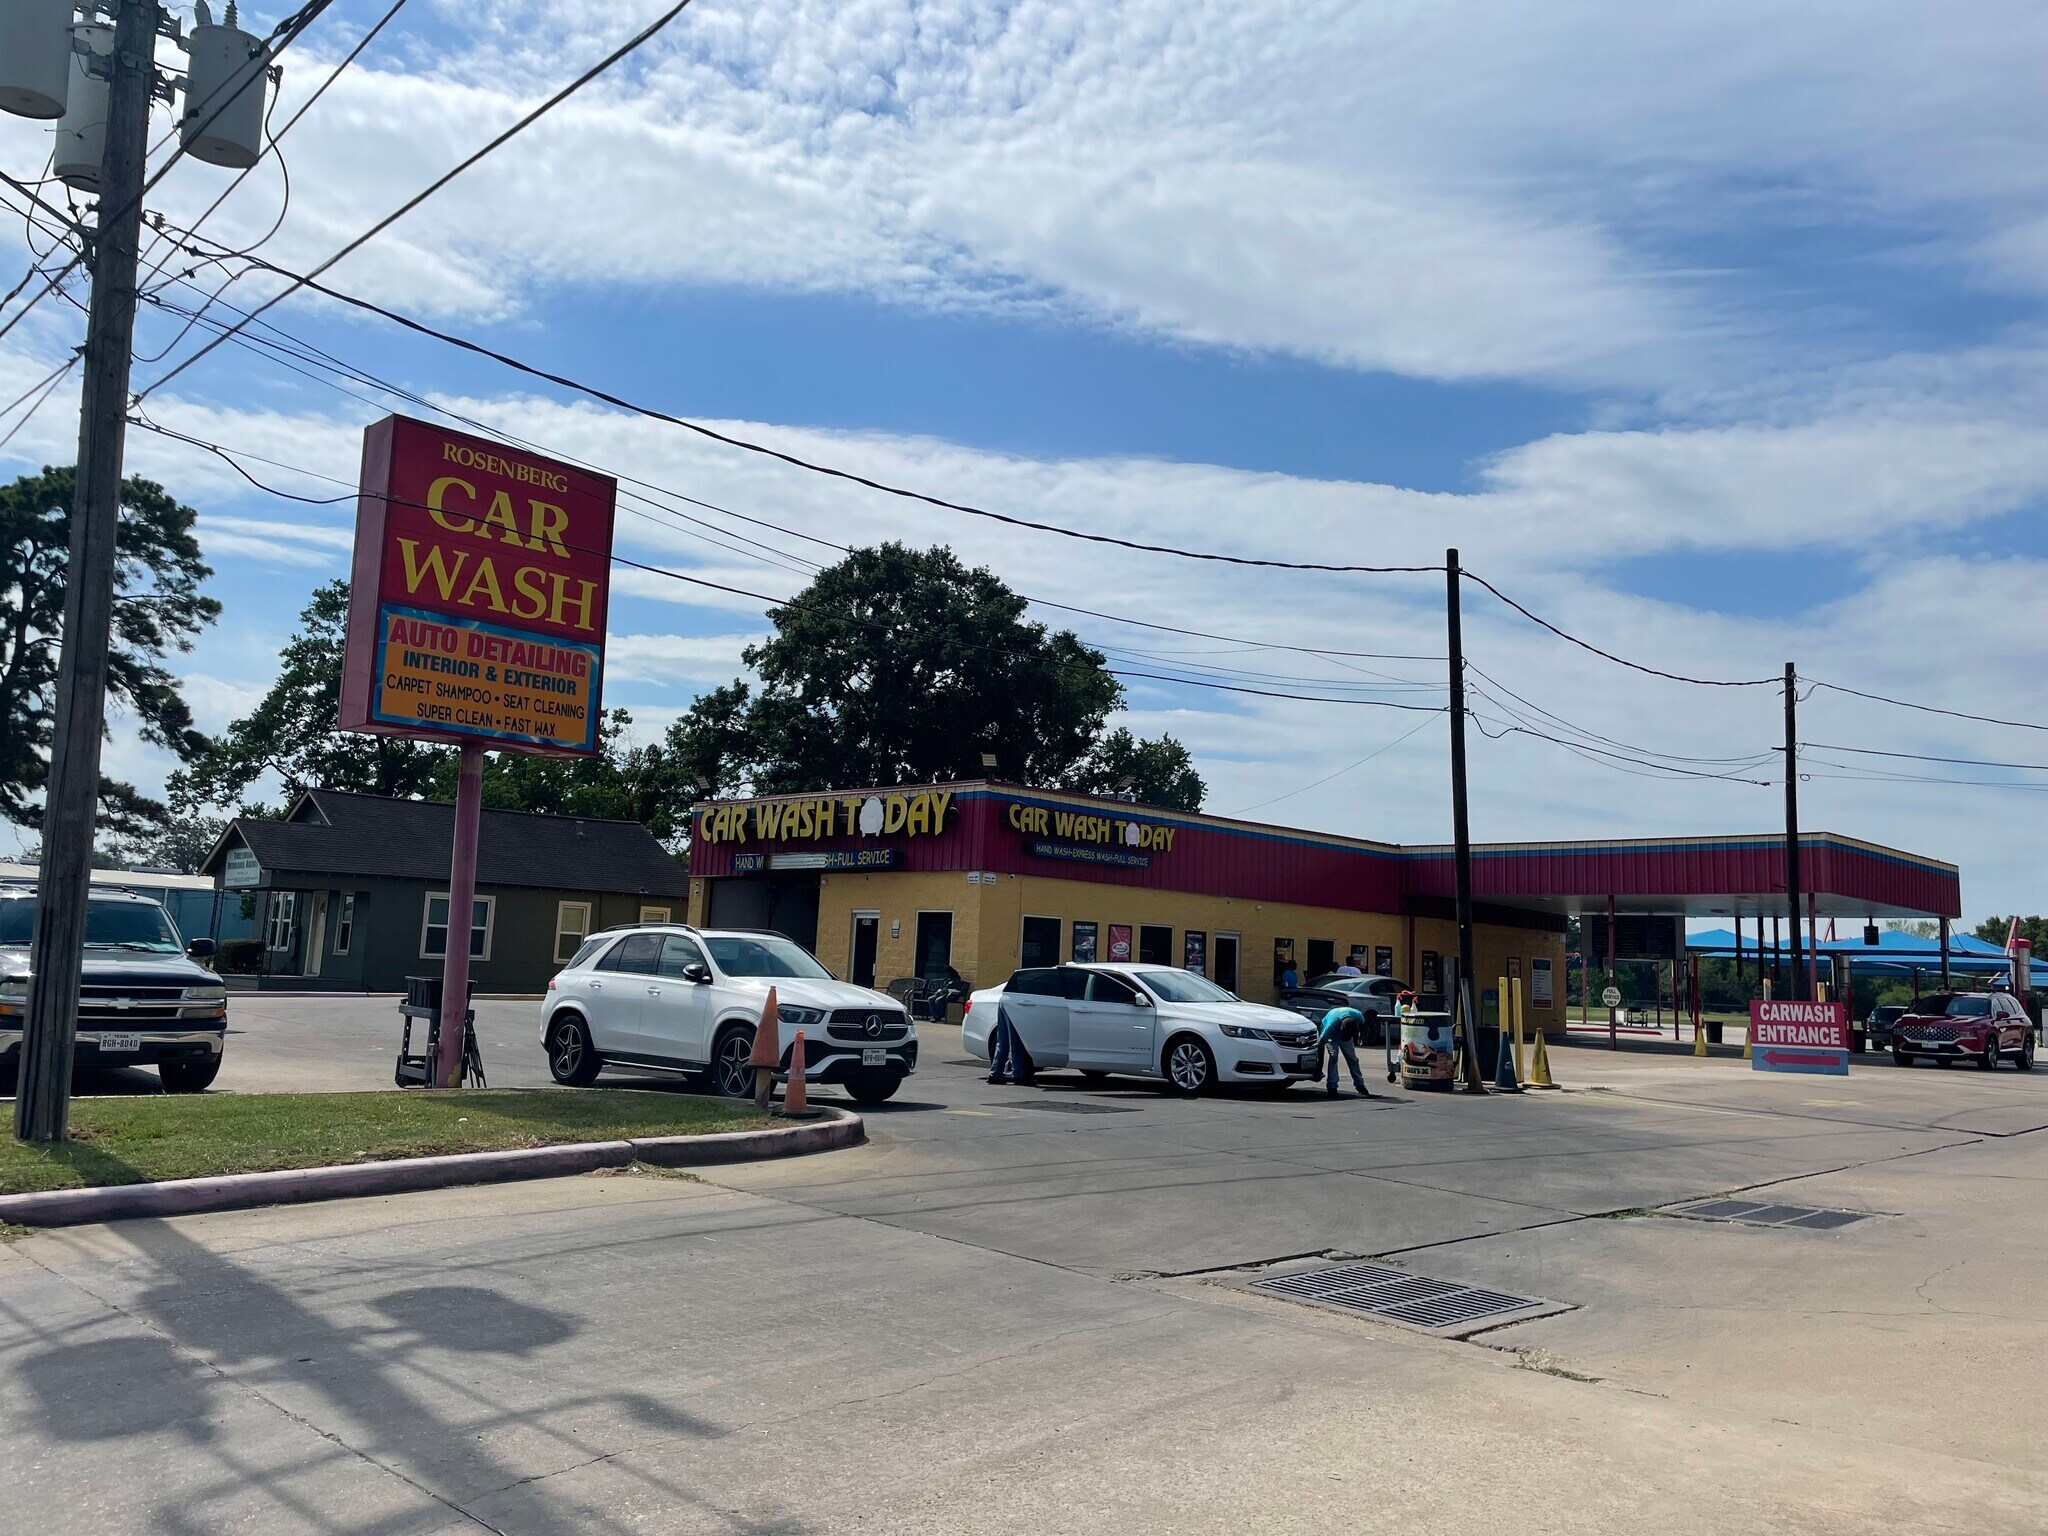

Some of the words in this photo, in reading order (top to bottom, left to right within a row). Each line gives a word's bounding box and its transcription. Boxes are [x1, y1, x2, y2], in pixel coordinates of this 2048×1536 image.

[443, 442, 568, 493] ROSENBERG
[427, 477, 570, 558] CAR
[397, 537, 598, 631] WASH
[389, 618, 458, 653] AUTO
[467, 632, 587, 678] DETAILING
[403, 651, 479, 678] INTERIOR
[485, 666, 498, 682] &
[504, 668, 577, 695] EXTERIOR
[387, 674, 432, 695] CARPET
[436, 683, 491, 704] SHAMPOO
[503, 694, 530, 711] SEAT
[534, 699, 584, 719] CLEANING
[417, 703, 451, 721] SUPER
[456, 710, 493, 727] CLEAN
[504, 716, 531, 732] FAST
[535, 721, 555, 736] WAX
[700, 805, 748, 844] CAR
[756, 800, 835, 842] WASH
[1009, 804, 1048, 836] CAR
[1055, 811, 1110, 844] WASH
[735, 857, 754, 869] HAND
[857, 850, 890, 865] SERVICE
[1036, 844, 1052, 854] HAND
[1127, 856, 1148, 867] SERVICE
[1757, 1024, 1840, 1044] ENTRANCE
[1760, 1003, 1835, 1023] CARWASH
